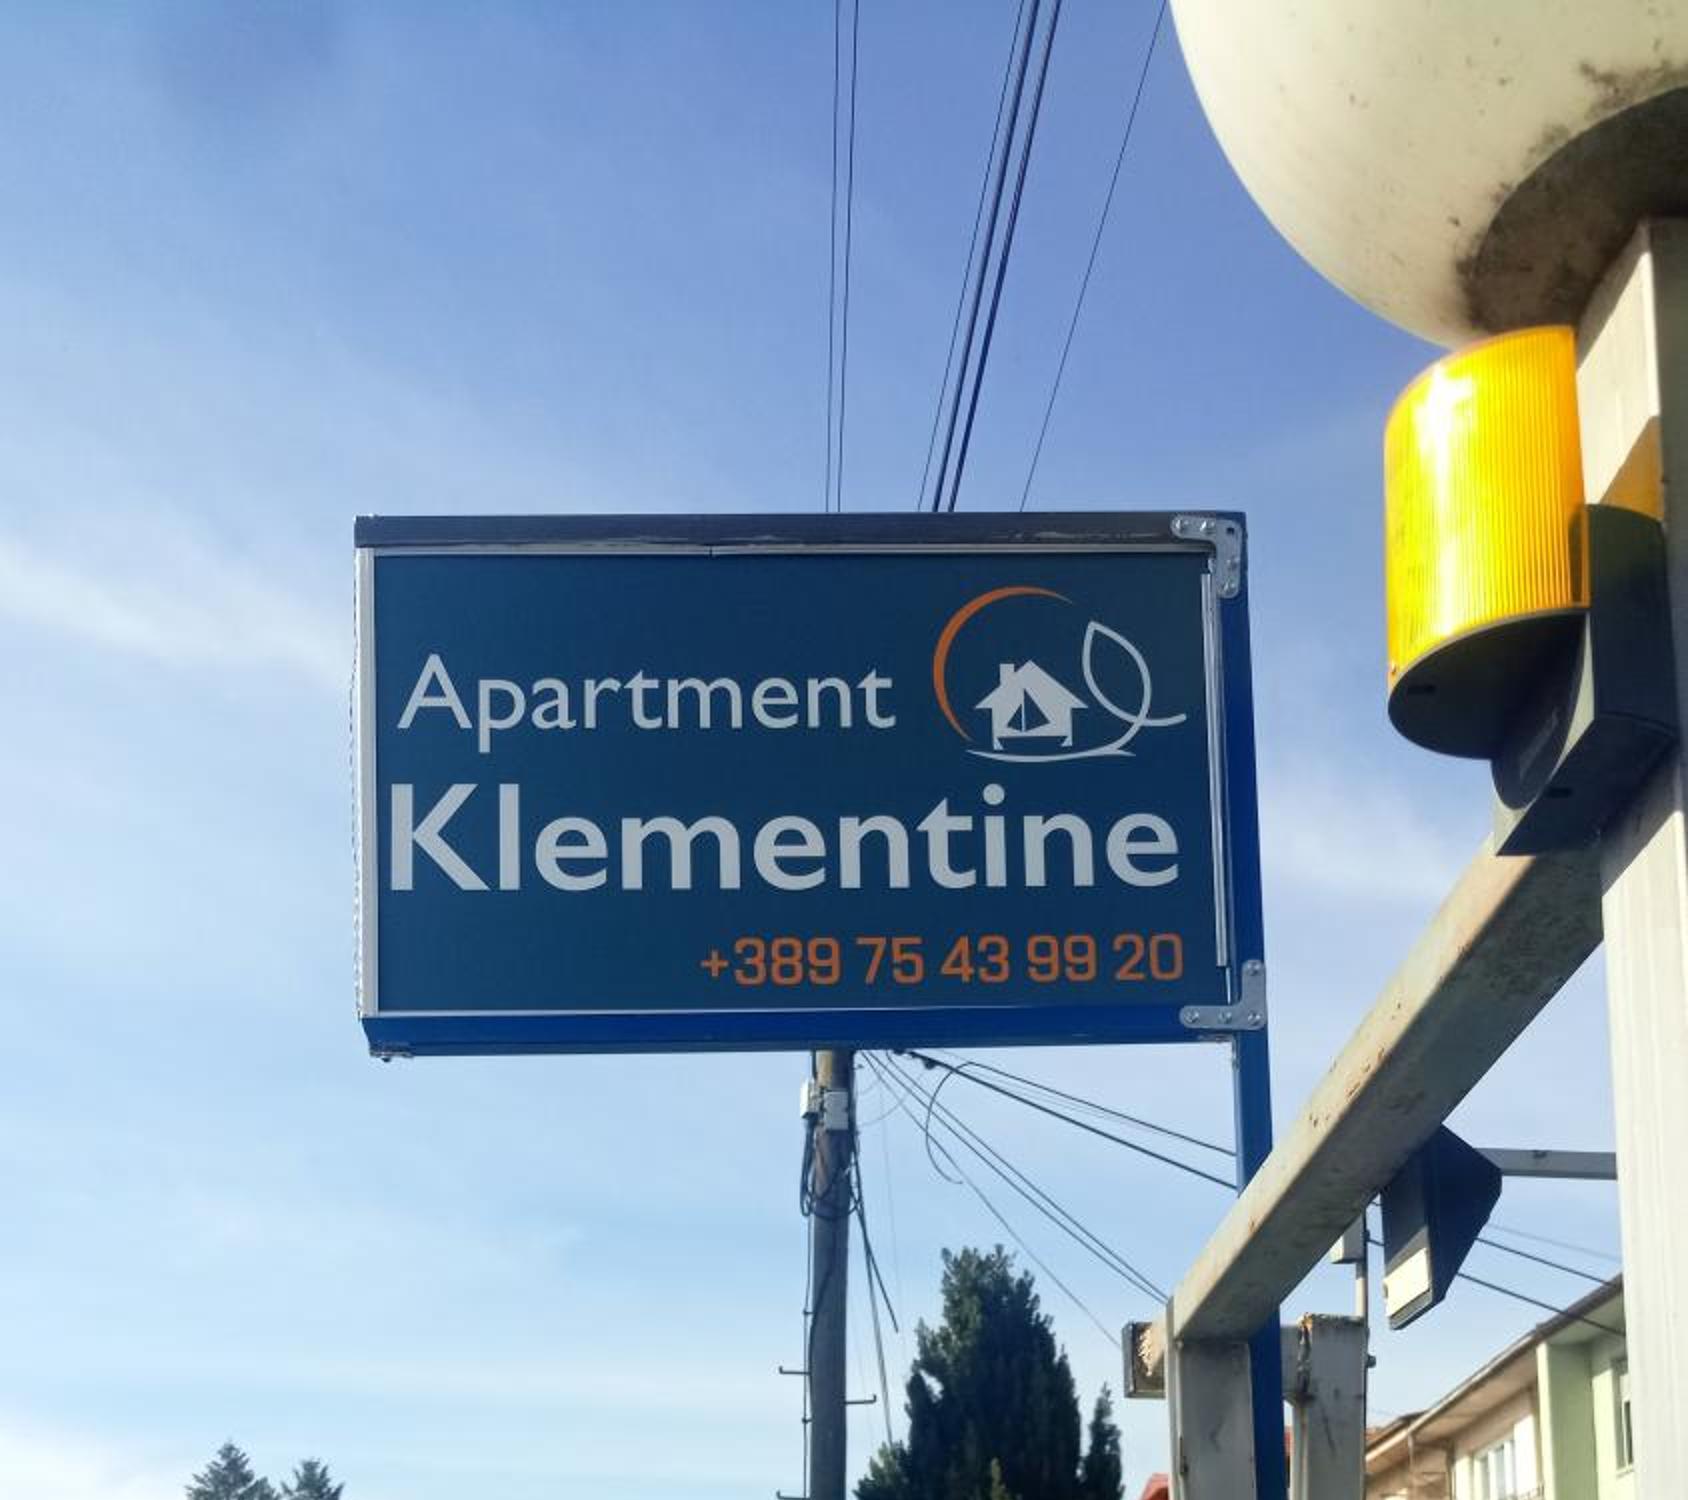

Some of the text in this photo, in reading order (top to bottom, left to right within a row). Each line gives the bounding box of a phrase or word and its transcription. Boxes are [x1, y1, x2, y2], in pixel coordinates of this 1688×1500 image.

[397, 653, 896, 754] Apartment
[390, 783, 1180, 892] Klementine
[700, 934, 1183, 986] +389 75 43 99 20
